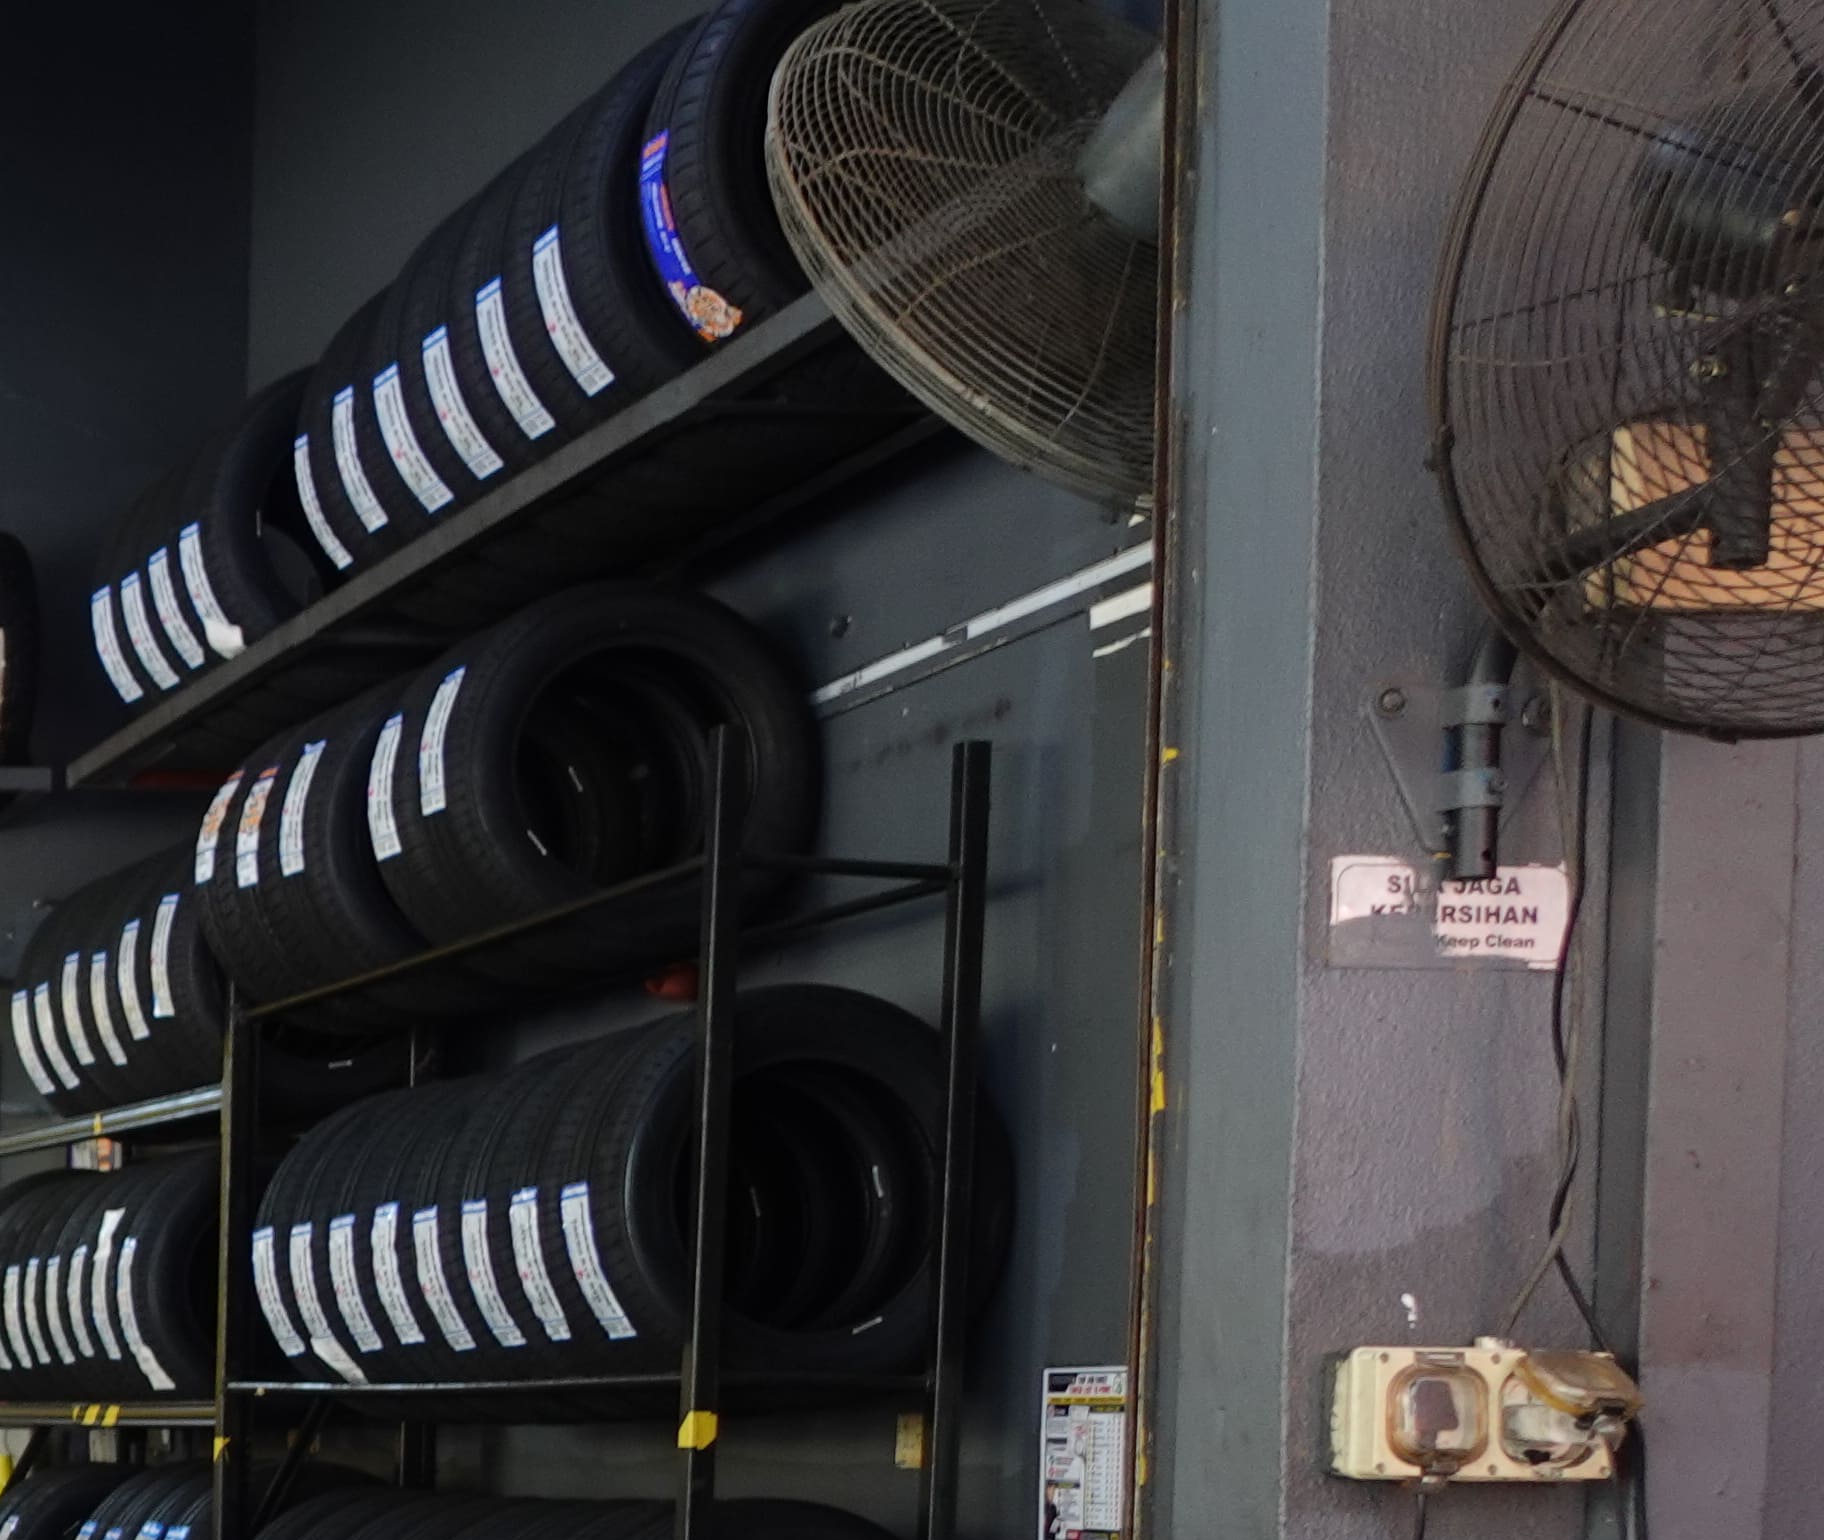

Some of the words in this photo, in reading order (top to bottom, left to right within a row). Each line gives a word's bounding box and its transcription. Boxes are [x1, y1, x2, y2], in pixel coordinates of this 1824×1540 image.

[1453, 876, 1521, 896] JAGA
[1437, 934, 1479, 949] Keep
[1486, 934, 1535, 949] Clean
